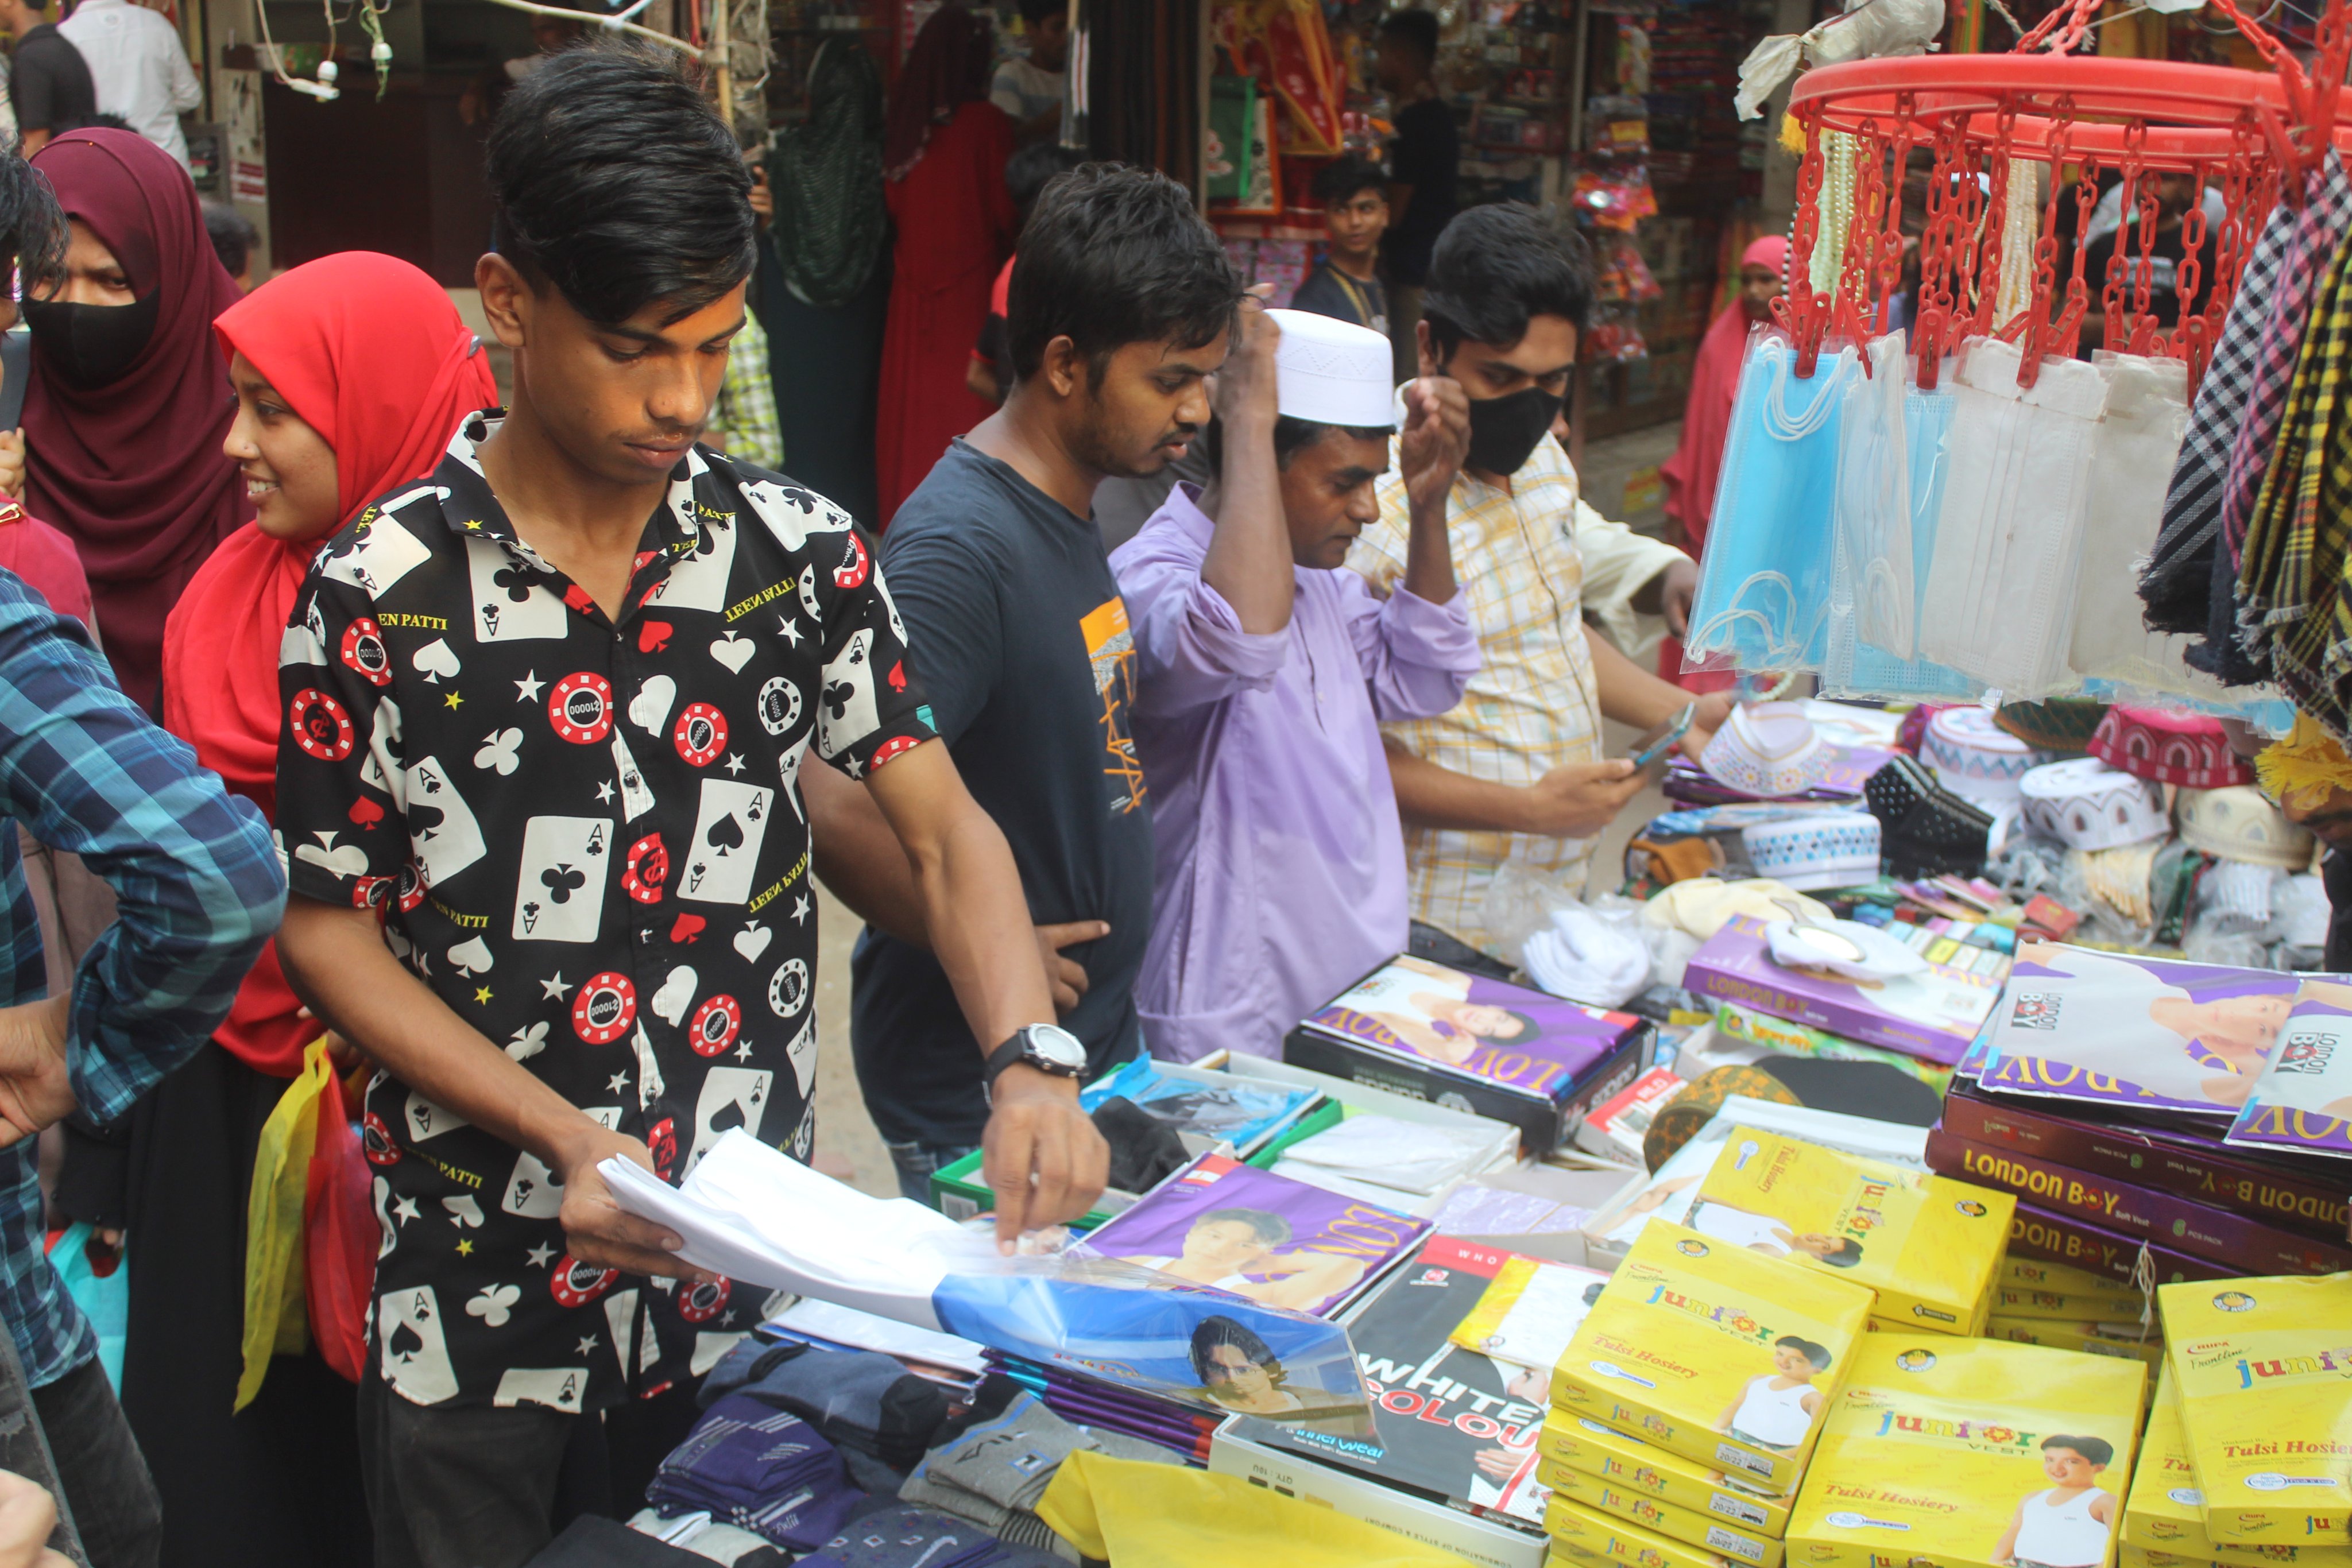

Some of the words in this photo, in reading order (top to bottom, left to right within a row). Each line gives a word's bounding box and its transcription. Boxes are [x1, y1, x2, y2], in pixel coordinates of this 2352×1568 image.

[378, 613, 399, 626] EN
[401, 614, 447, 630] PATTI
[483, 617, 500, 636] A
[852, 636, 865, 653] A
[420, 767, 436, 786] A
[750, 792, 763, 810] A
[588, 823, 604, 842] A
[690, 874, 703, 893] A
[451, 908, 489, 928] PATTI
[523, 915, 538, 934] A
[2011, 992, 2042, 1029] BOY
[2038, 993, 2064, 1031] LONDON
[2274, 1032, 2316, 1073] BOY
[2303, 1032, 2341, 1075] LONDON
[751, 1075, 764, 1093] A
[439, 1162, 483, 1190] PATTI
[1964, 1148, 2062, 1199] LONDON
[2068, 1180, 2119, 1214] BOY
[2202, 1171, 2252, 1200] BOY
[1846, 1175, 1894, 1238] junior
[2260, 1182, 2352, 1225] ONDON
[2066, 1235, 2117, 1267] BOY
[413, 1291, 430, 1310] A
[1646, 1284, 1774, 1341] junior
[2197, 1341, 2230, 1350] RUPA
[1592, 1336, 1635, 1356] Tulsi
[1637, 1350, 1699, 1379] Hosiery
[2190, 1346, 2252, 1370] Frontline
[562, 1374, 575, 1391] A
[1359, 1342, 1539, 1425] WHITE
[1612, 1404, 1674, 1438] junior
[1875, 1410, 2036, 1447] junior
[1719, 1452, 1742, 1467] 20/22
[1968, 1443, 2031, 1455] VEST
[2224, 1442, 2278, 1458] Tulsi
[2285, 1440, 2352, 1454] Hosie
[1602, 1457, 1668, 1491] junior
[1600, 1489, 1664, 1523] junior
[1713, 1502, 1736, 1516] 20/22
[1825, 1484, 1875, 1499] Tulsi
[1879, 1491, 1958, 1513] Hosiery
[1414, 1534, 1438, 1546] STYLE
[1709, 1536, 1732, 1550] 20/22
[1737, 1546, 1760, 1559] 24/26
